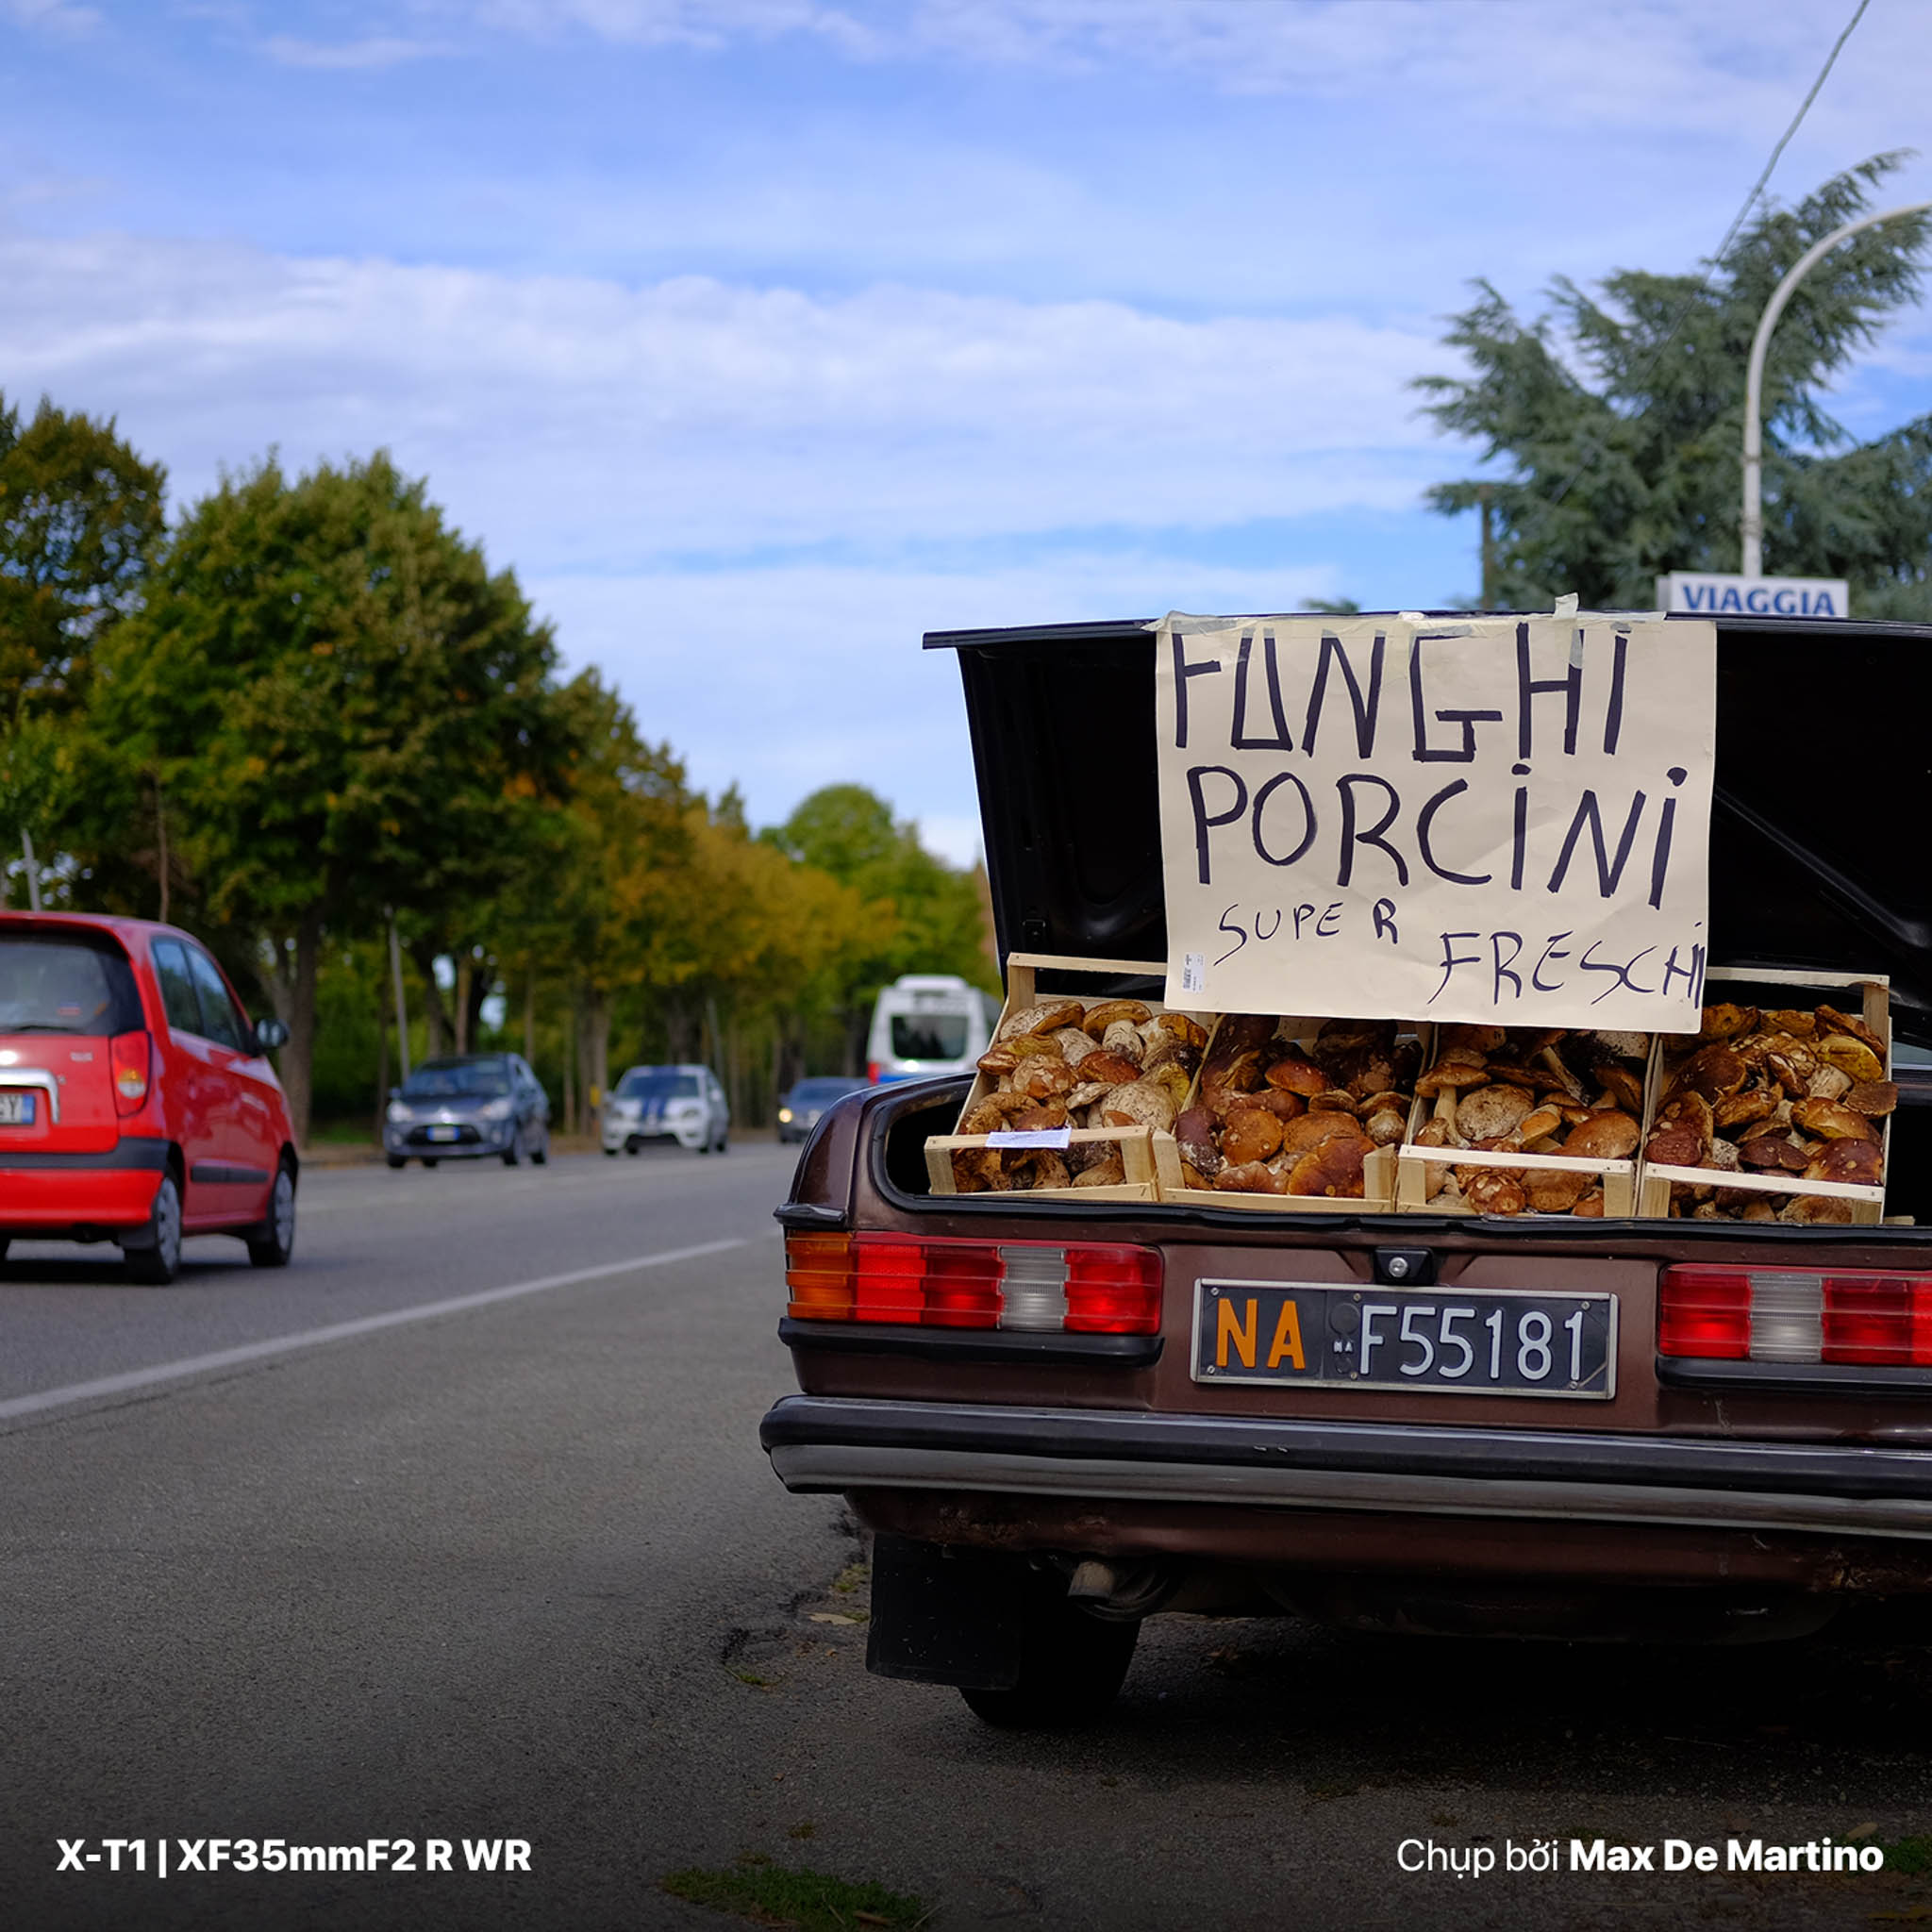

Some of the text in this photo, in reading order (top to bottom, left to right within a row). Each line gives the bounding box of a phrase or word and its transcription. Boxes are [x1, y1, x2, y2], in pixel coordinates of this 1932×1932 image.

[1682, 585, 1837, 616] VIAGGIA
[1216, 1297, 1306, 1370] NA
[1360, 1304, 1584, 1382] F55181
